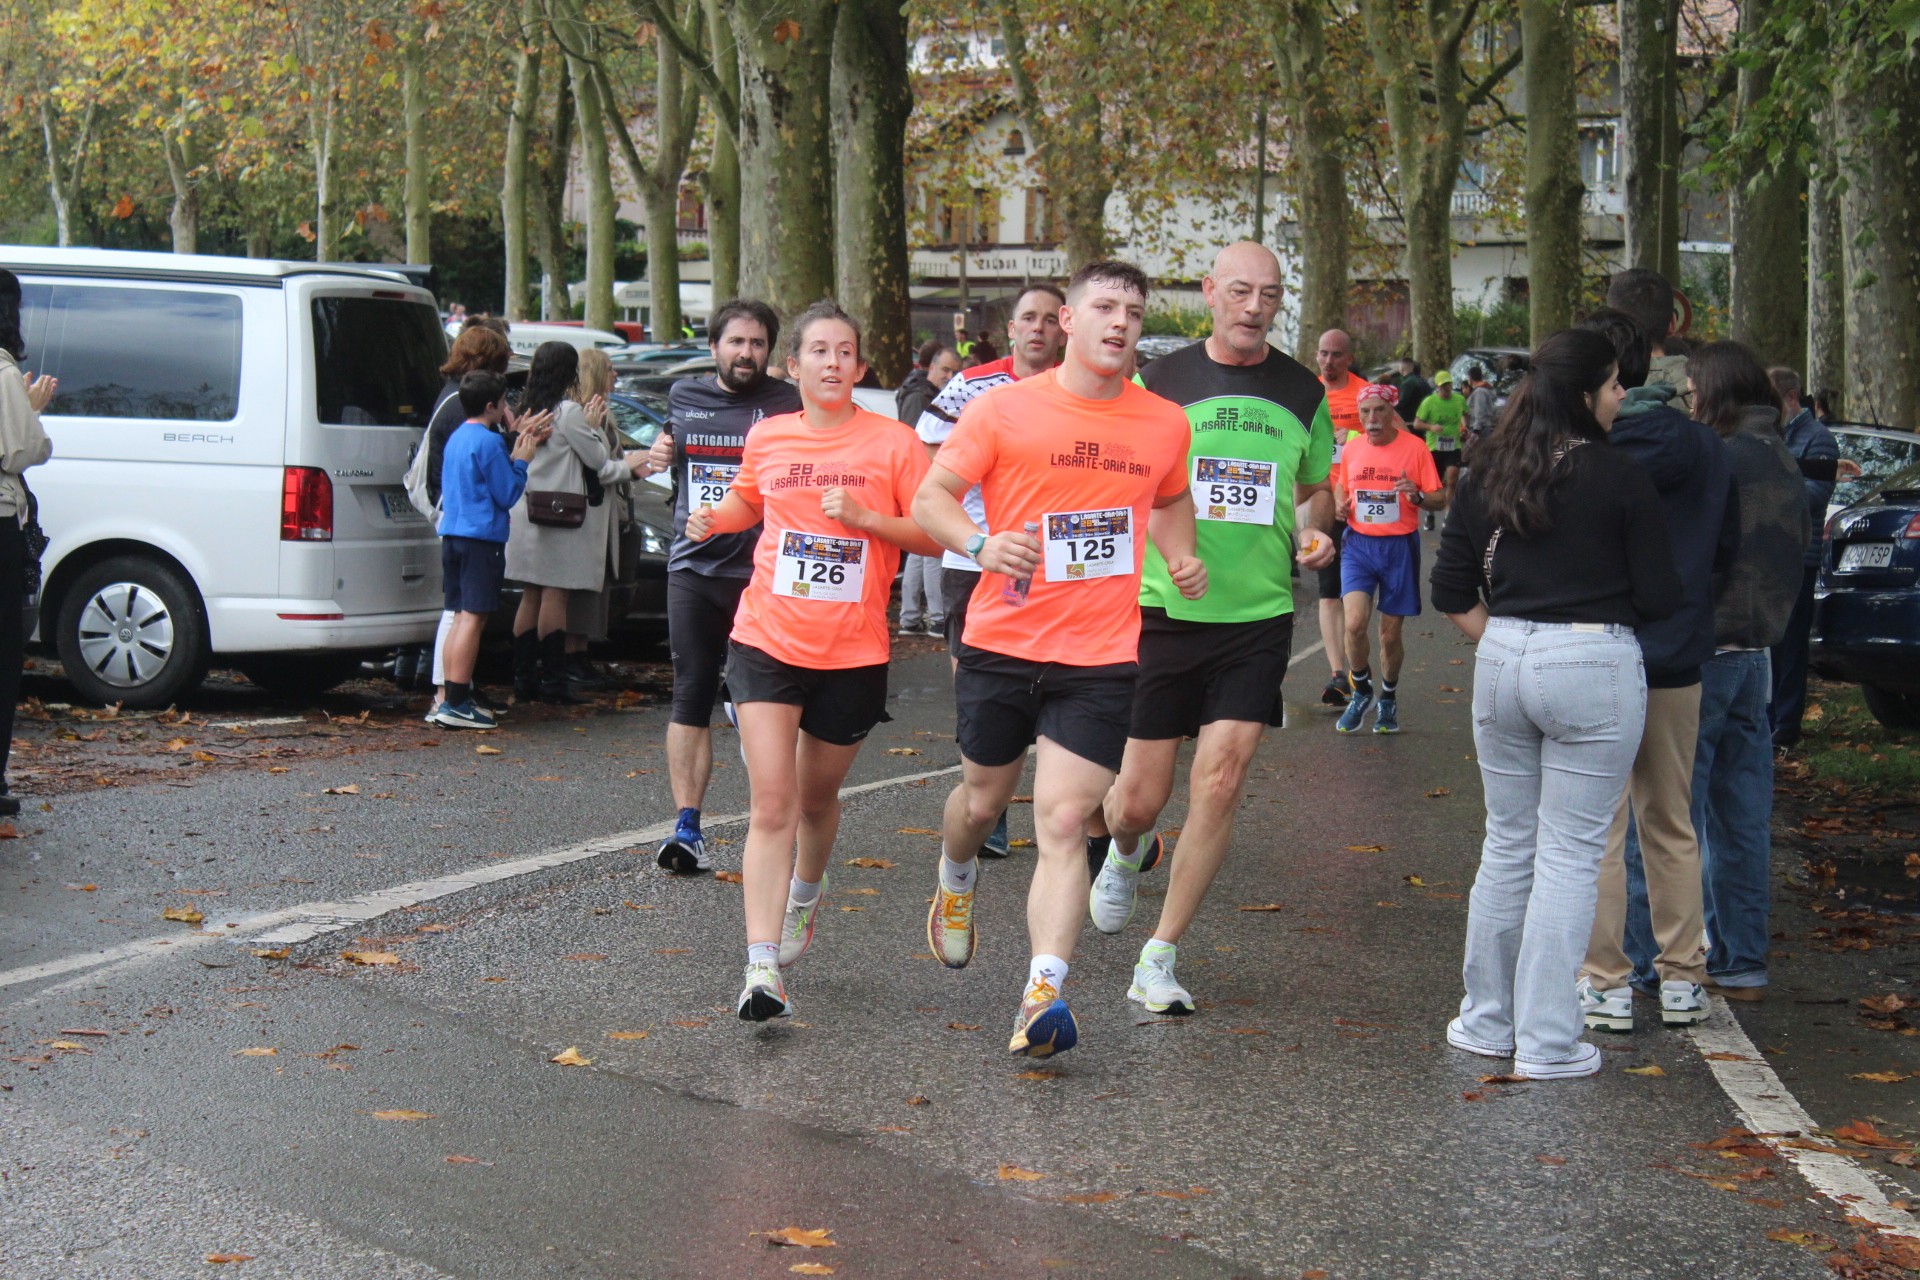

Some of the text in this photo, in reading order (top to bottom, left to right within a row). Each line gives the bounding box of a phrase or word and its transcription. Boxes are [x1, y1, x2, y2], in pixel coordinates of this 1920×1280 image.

[1216, 408, 1238, 420] 25
[163, 433, 234, 444] BEACH
[686, 434, 744, 447] ASTIGARRA
[1075, 440, 1099, 456] 28
[790, 464, 814, 475] 28
[700, 486, 730, 502] 29
[1210, 484, 1258, 506] 539
[1368, 504, 1385, 515] 28
[1067, 538, 1115, 561] 125
[1869, 546, 1890, 564] FSP
[797, 560, 845, 585] 126
